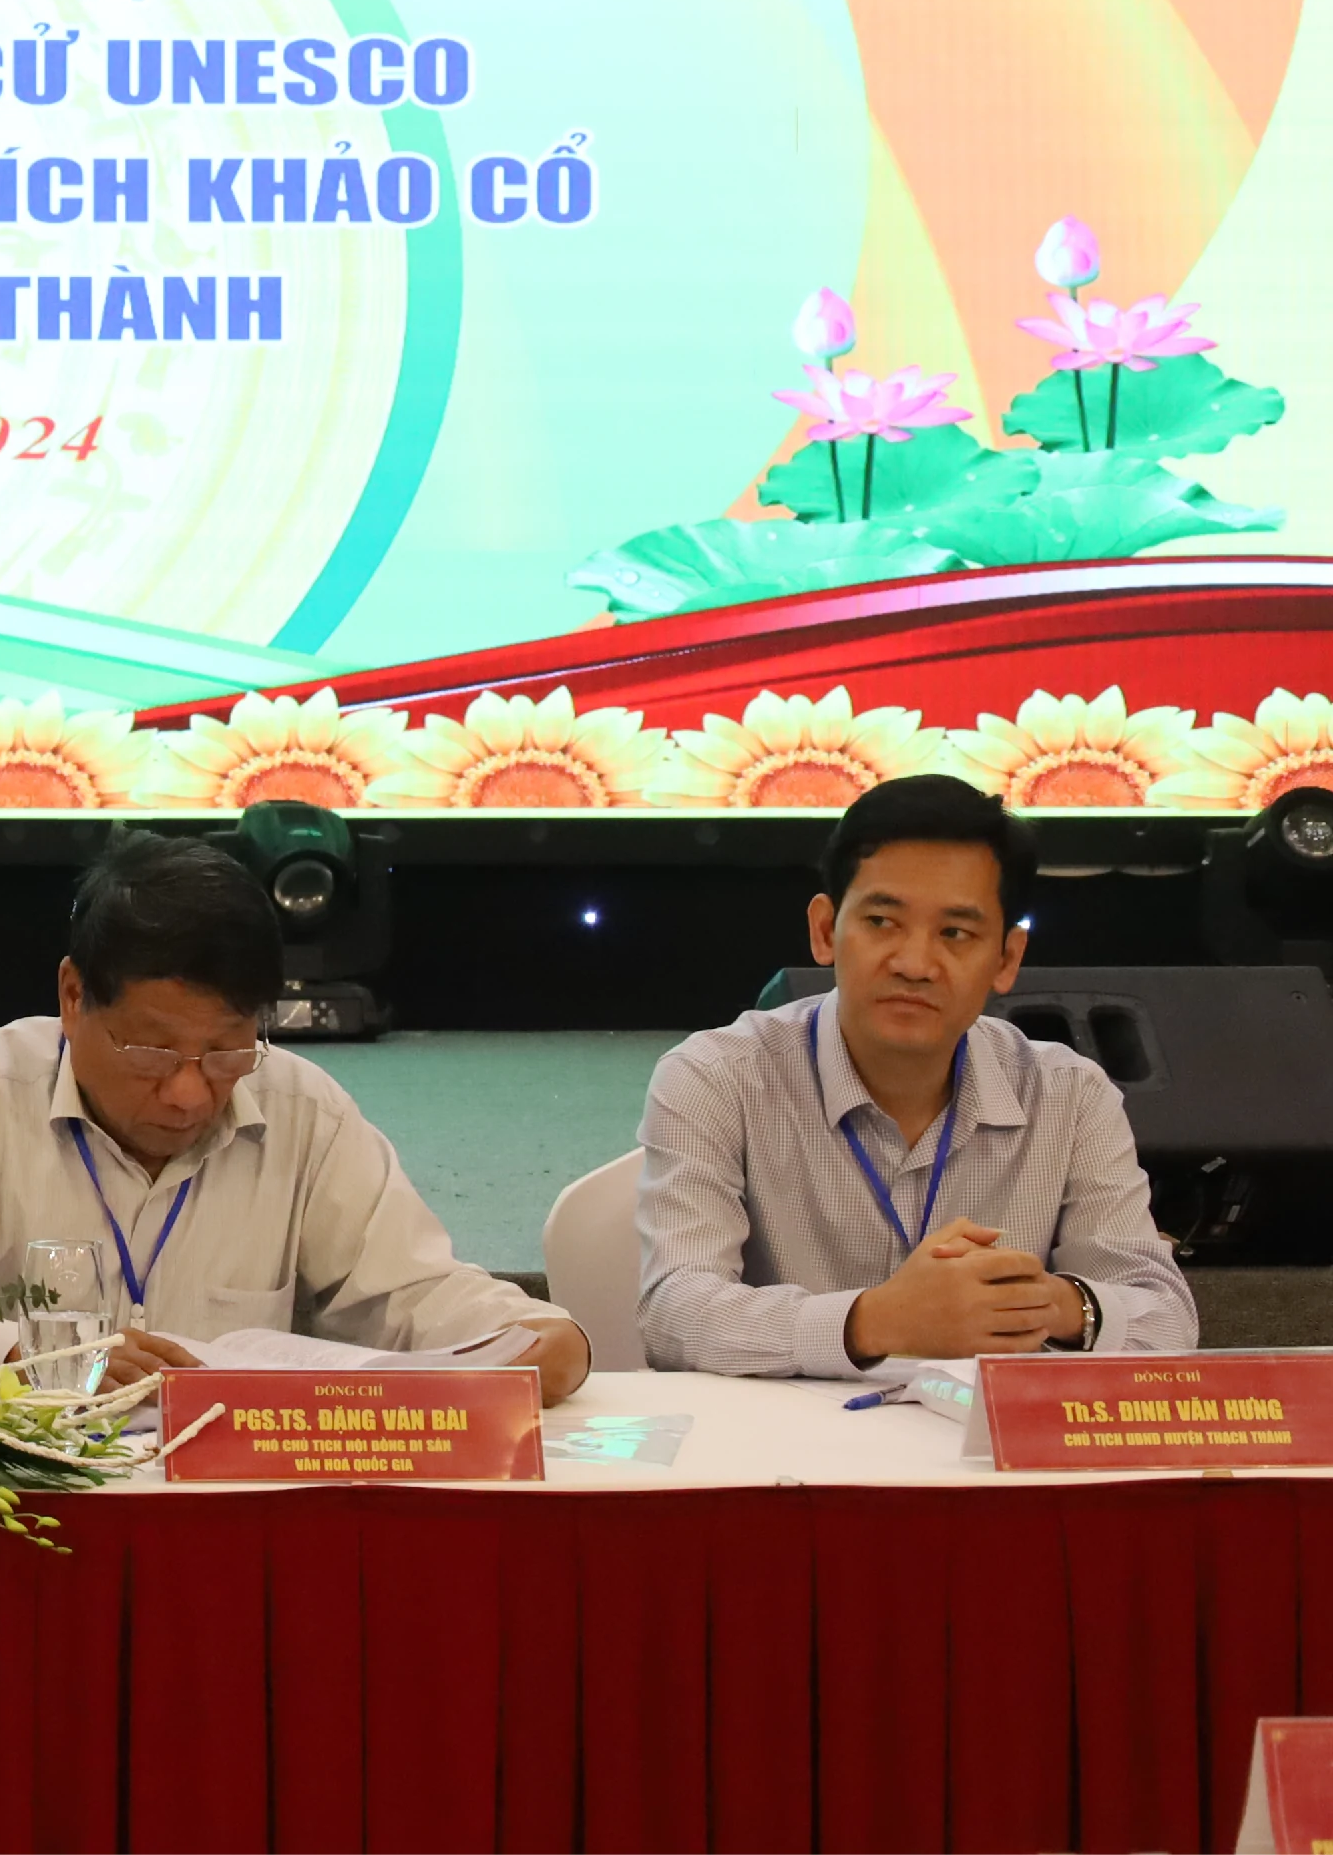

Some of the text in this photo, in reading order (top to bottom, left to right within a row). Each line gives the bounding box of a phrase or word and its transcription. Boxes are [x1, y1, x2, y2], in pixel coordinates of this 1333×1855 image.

[107, 37, 469, 106] UNESCO
[188, 141, 434, 224] KHẢO
[471, 133, 592, 224] CỔ
[233, 1405, 467, 1434] PGS.TS. ĐẶNG VĂN BÀI
[1062, 1401, 1114, 1423] Th.S.
[1175, 1397, 1219, 1421] VĂN
[1224, 1397, 1284, 1420] HƯNG
